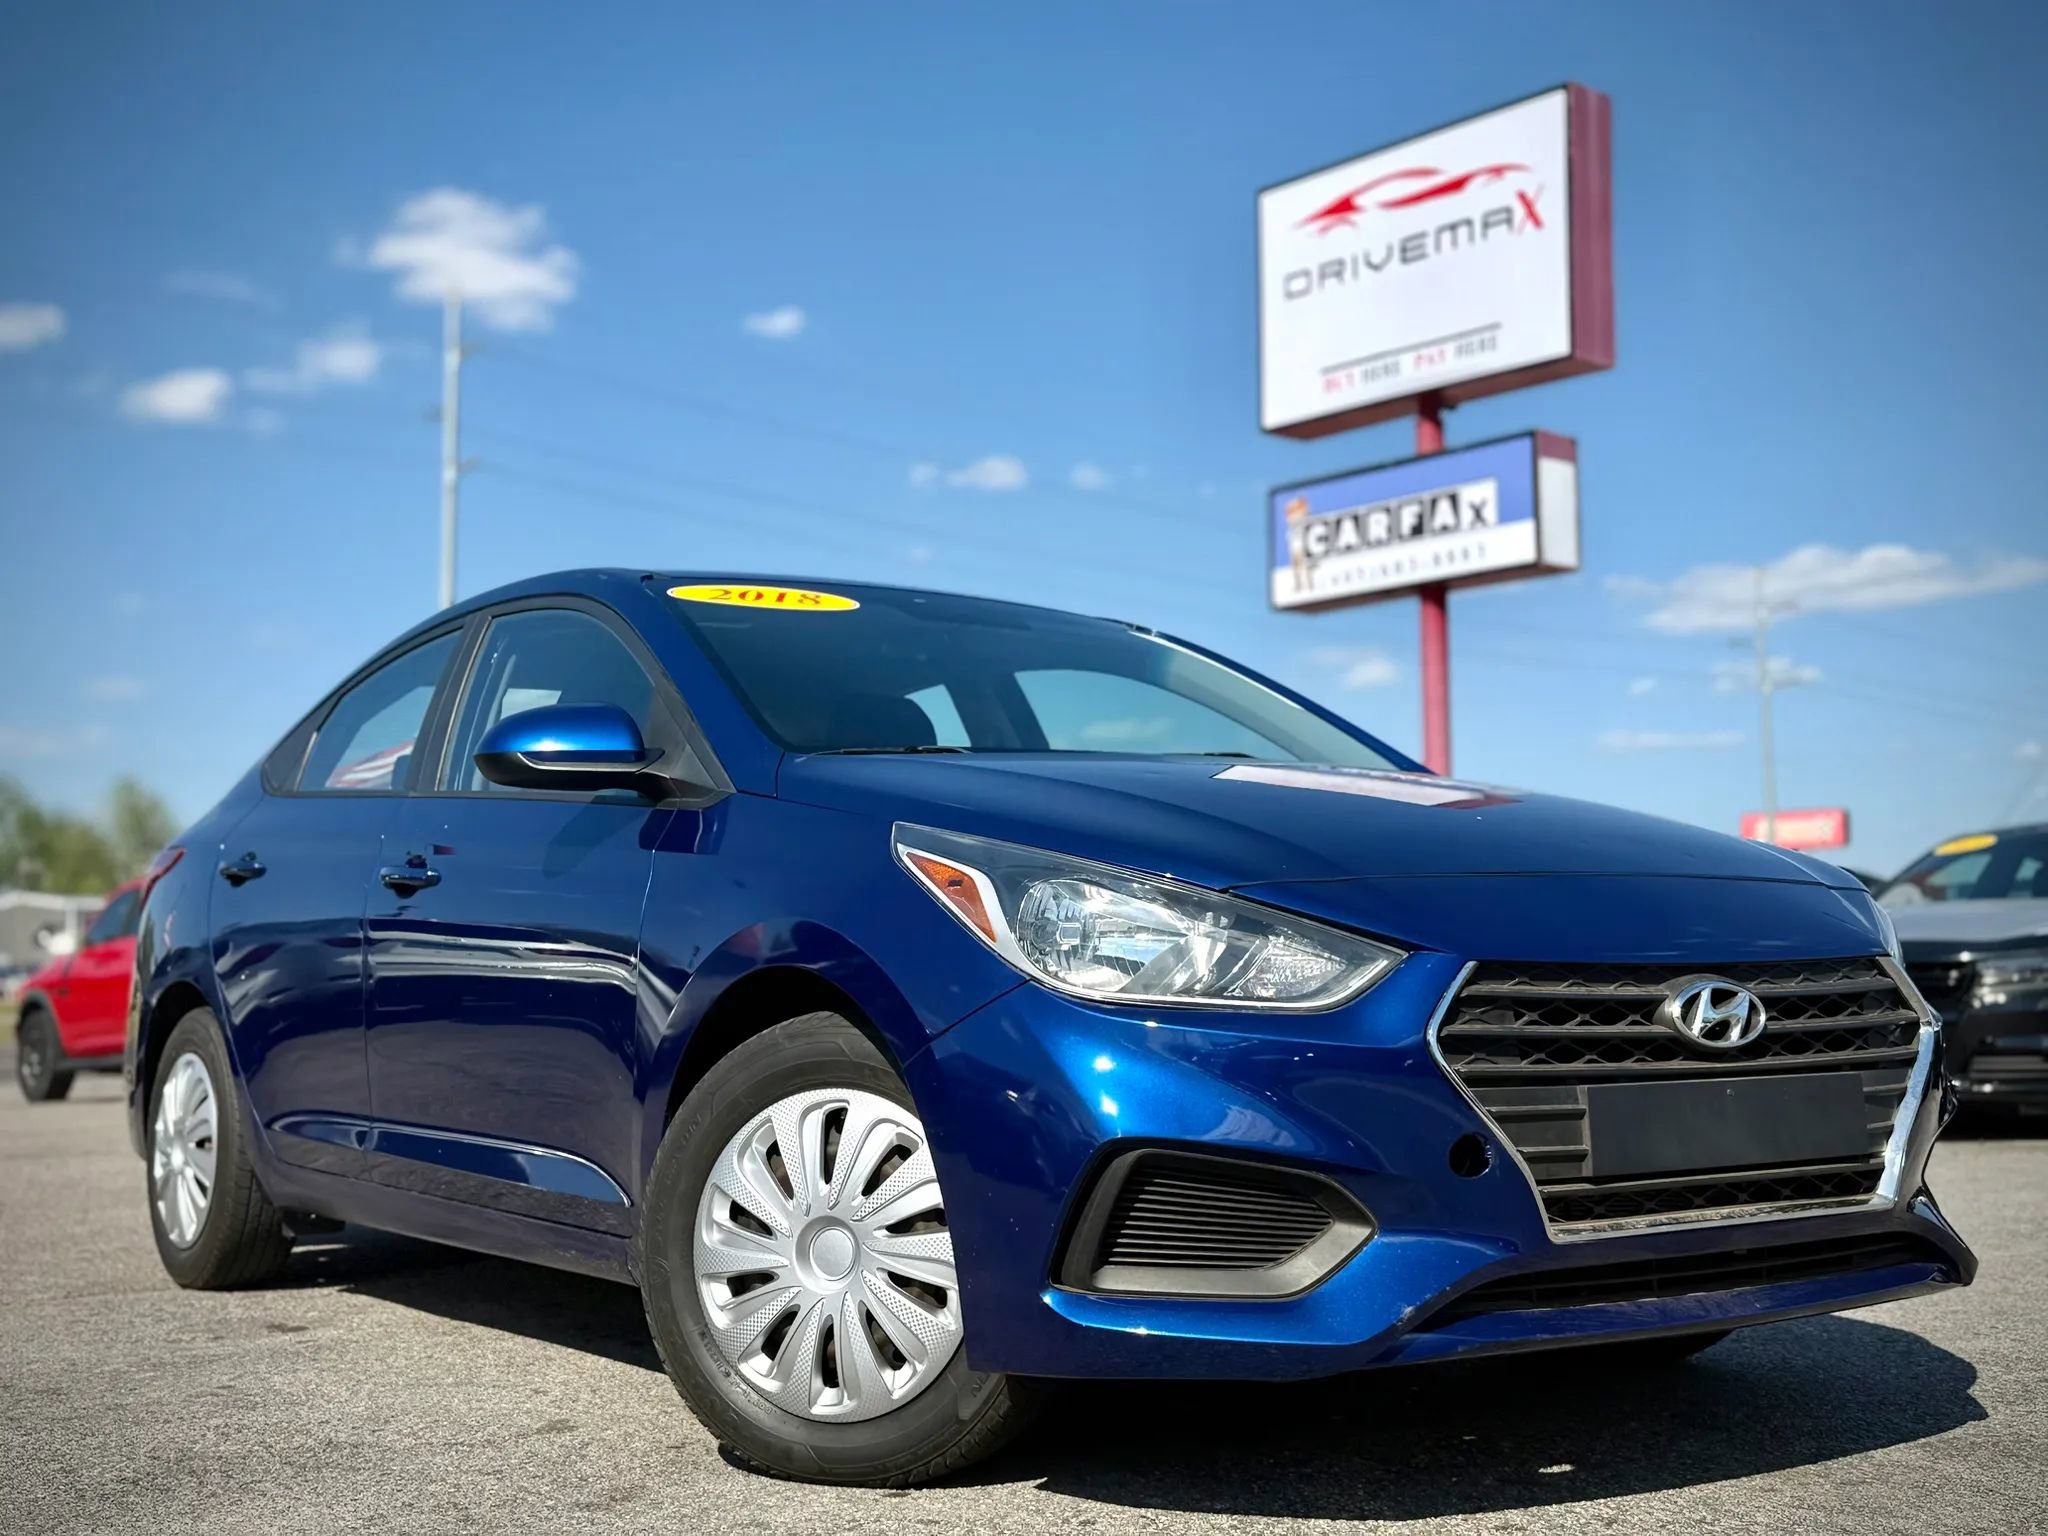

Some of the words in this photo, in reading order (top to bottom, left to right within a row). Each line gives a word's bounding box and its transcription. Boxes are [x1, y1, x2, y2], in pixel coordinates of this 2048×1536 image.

[1282, 184, 1544, 301] DRIVEMAX
[1306, 494, 1490, 556] CARFAX
[709, 588, 822, 605] 2018
